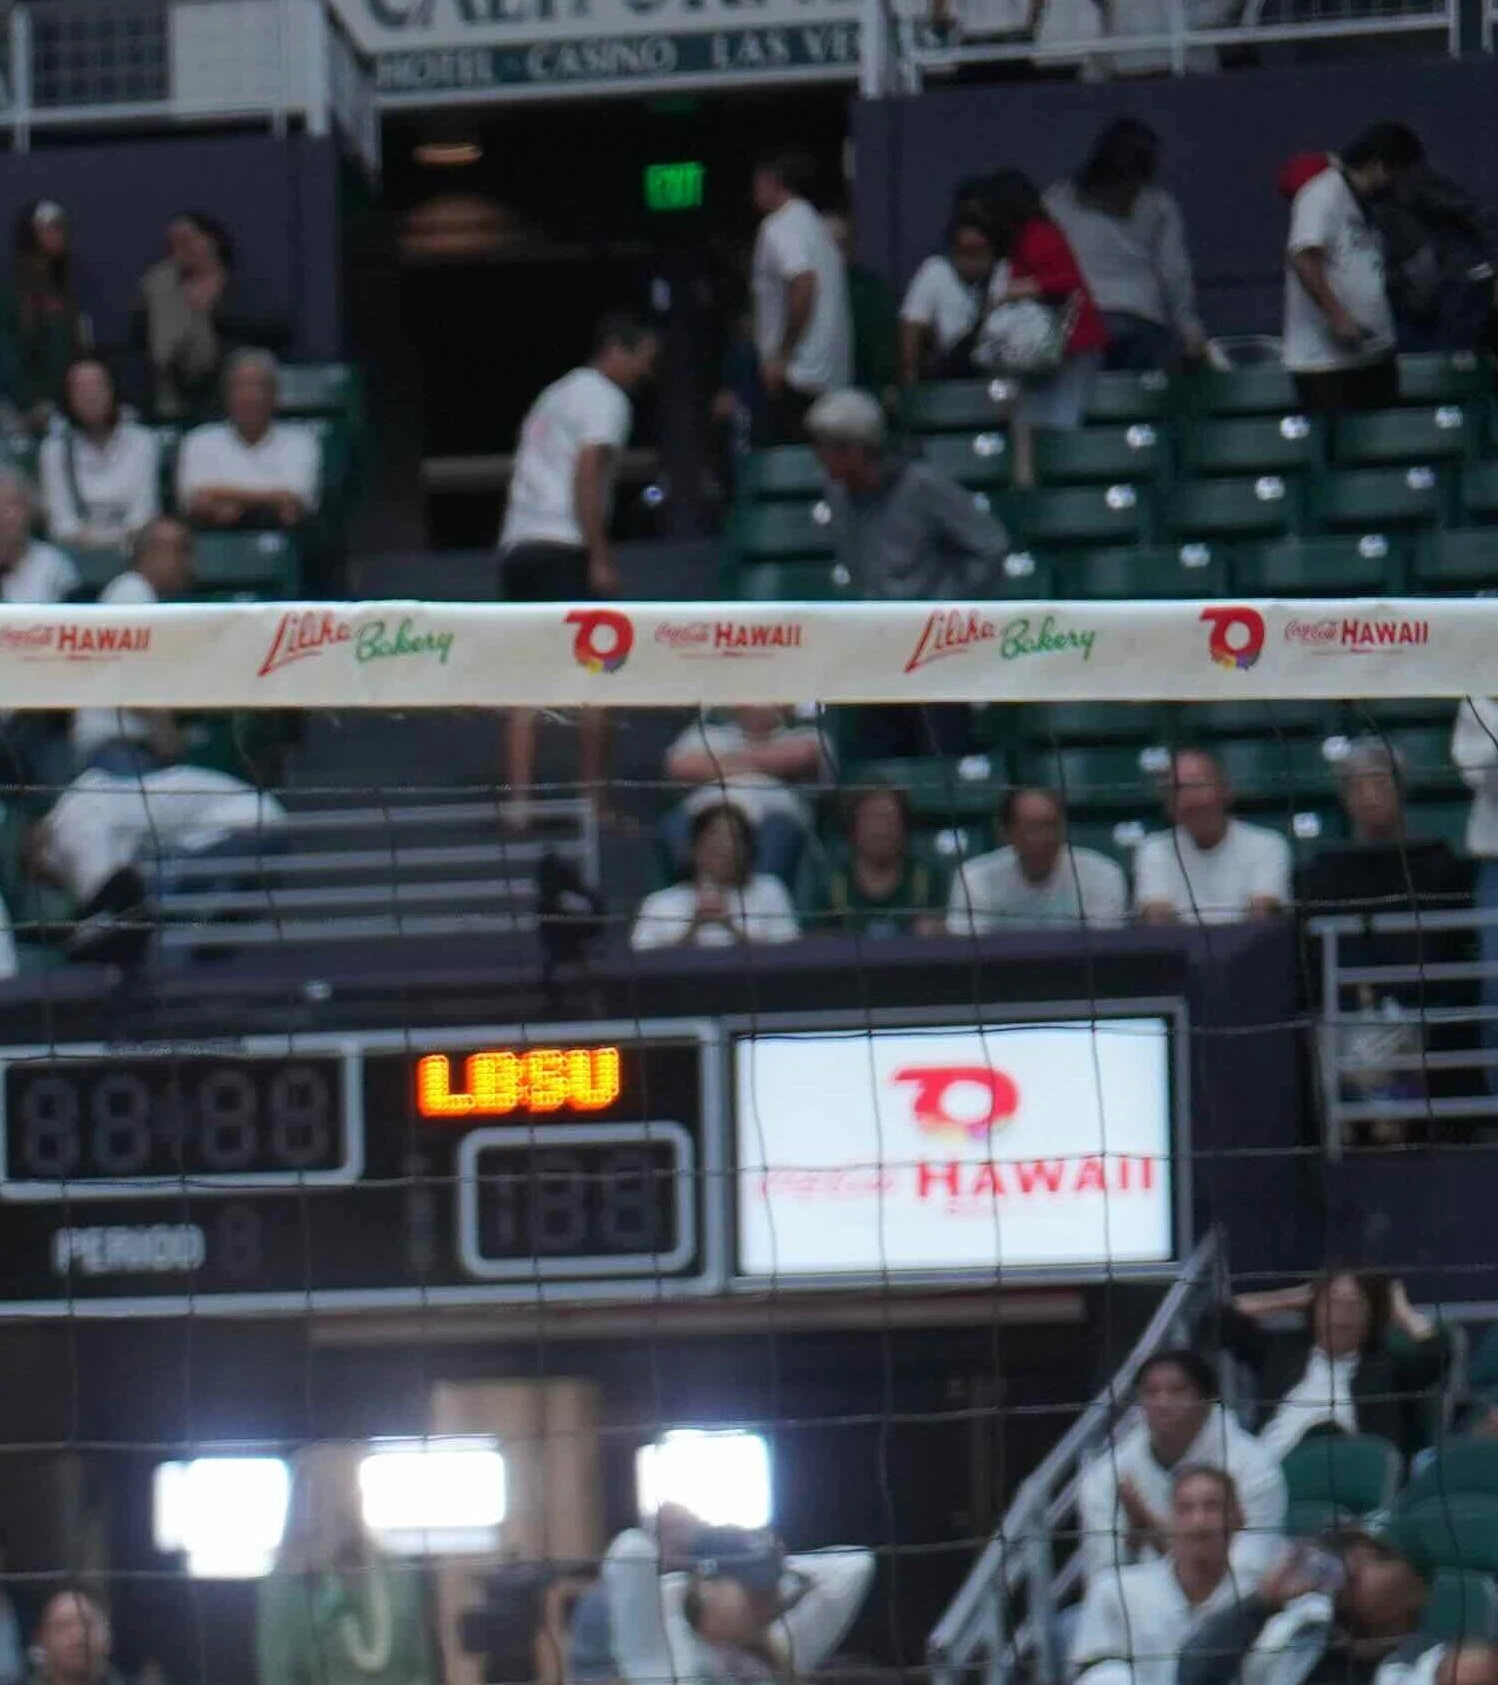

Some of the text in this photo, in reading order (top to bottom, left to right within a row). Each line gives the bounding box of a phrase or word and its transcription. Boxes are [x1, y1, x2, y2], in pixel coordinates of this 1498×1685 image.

[525, 37, 679, 82] CASINO
[710, 27, 790, 70] LAS
[58, 625, 151, 652] HAWAII
[714, 622, 801, 648] HAWAII
[1341, 619, 1428, 645] HAWAII
[418, 1046, 621, 1118] LBSU
[915, 1154, 1156, 1197] HAWAII
[53, 1222, 205, 1275] PERIOD
